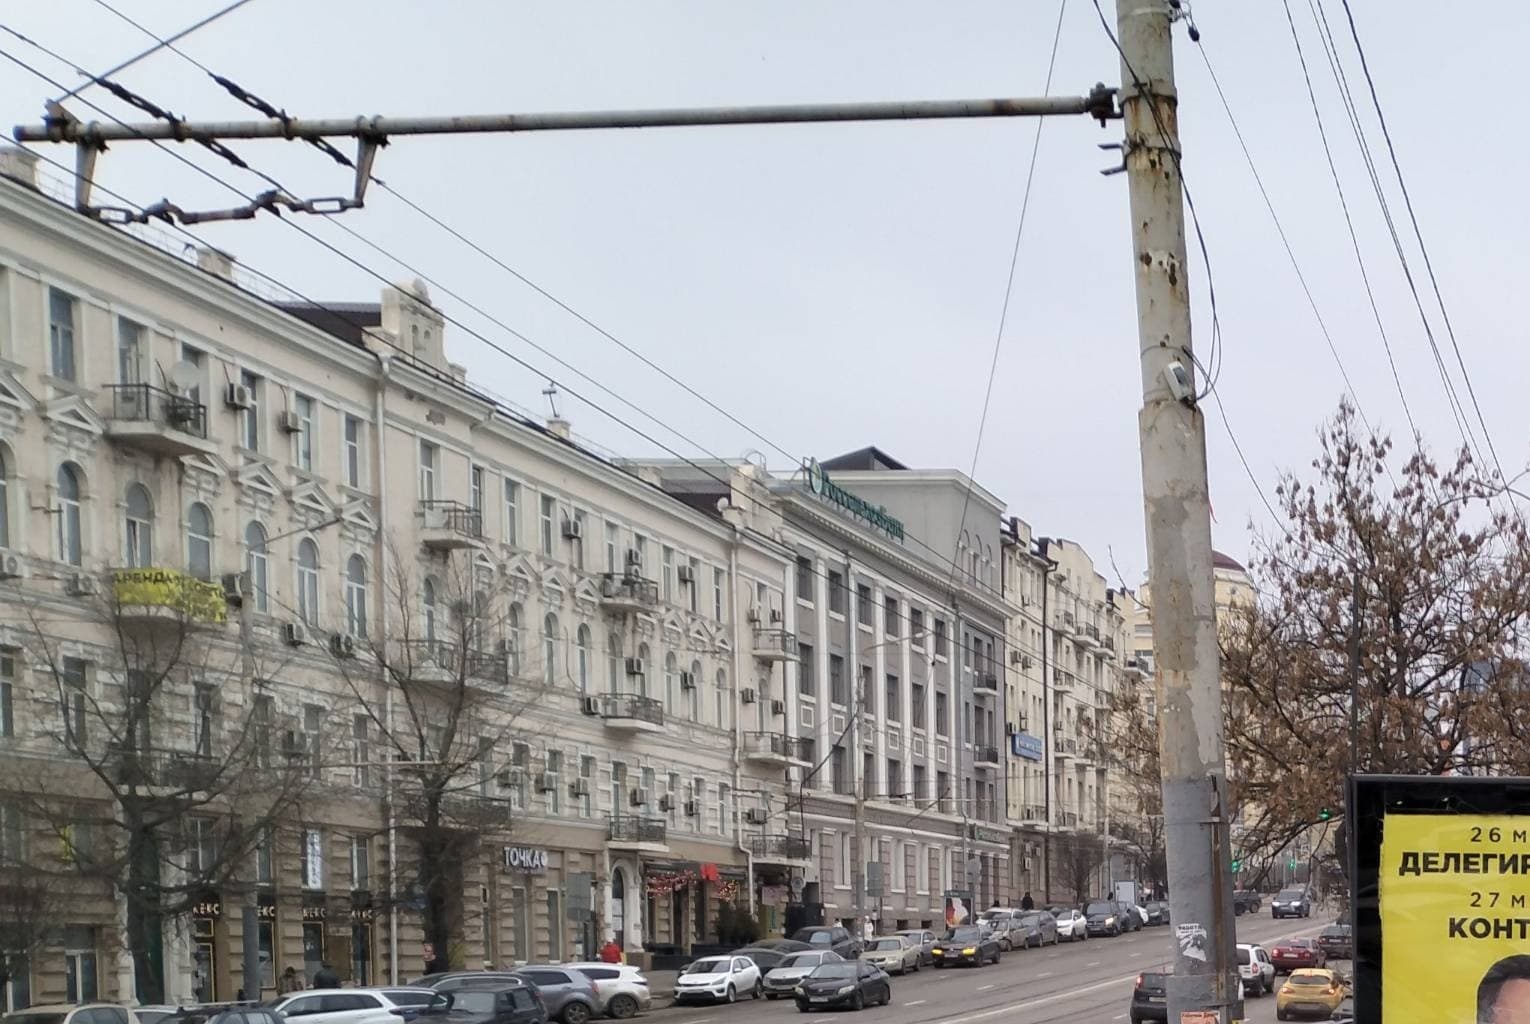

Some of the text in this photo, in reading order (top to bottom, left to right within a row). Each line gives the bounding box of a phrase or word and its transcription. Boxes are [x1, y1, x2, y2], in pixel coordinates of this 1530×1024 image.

[1471, 827, 1501, 843] 26
[503, 846, 541, 868] ТОЧКА
[1470, 892, 1500, 907] 27
